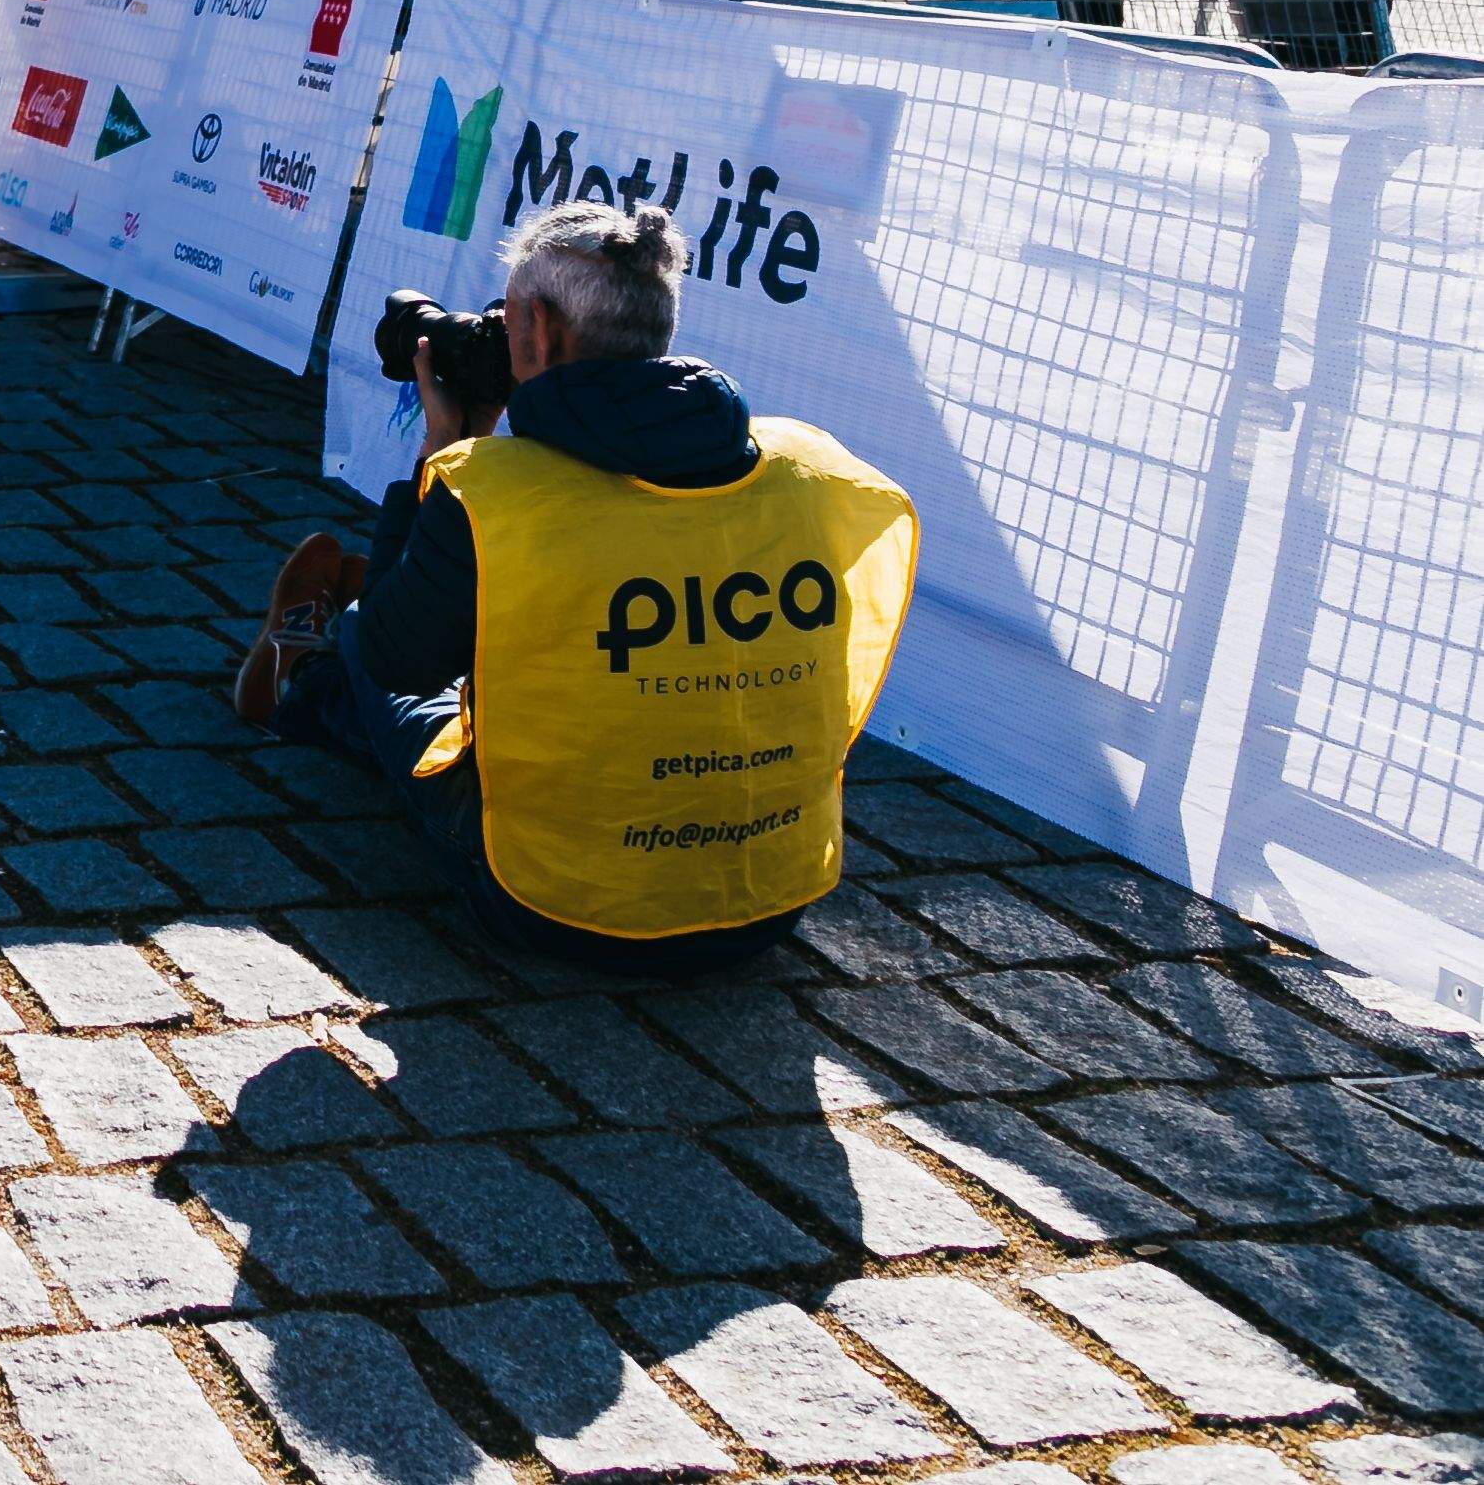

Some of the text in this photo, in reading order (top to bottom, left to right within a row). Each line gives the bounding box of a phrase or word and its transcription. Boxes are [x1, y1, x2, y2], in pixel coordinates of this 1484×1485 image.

[636, 659, 819, 695] TECHNOLOGY
[651, 742, 794, 780] getpica.com
[622, 805, 802, 853] info@pixport.es
